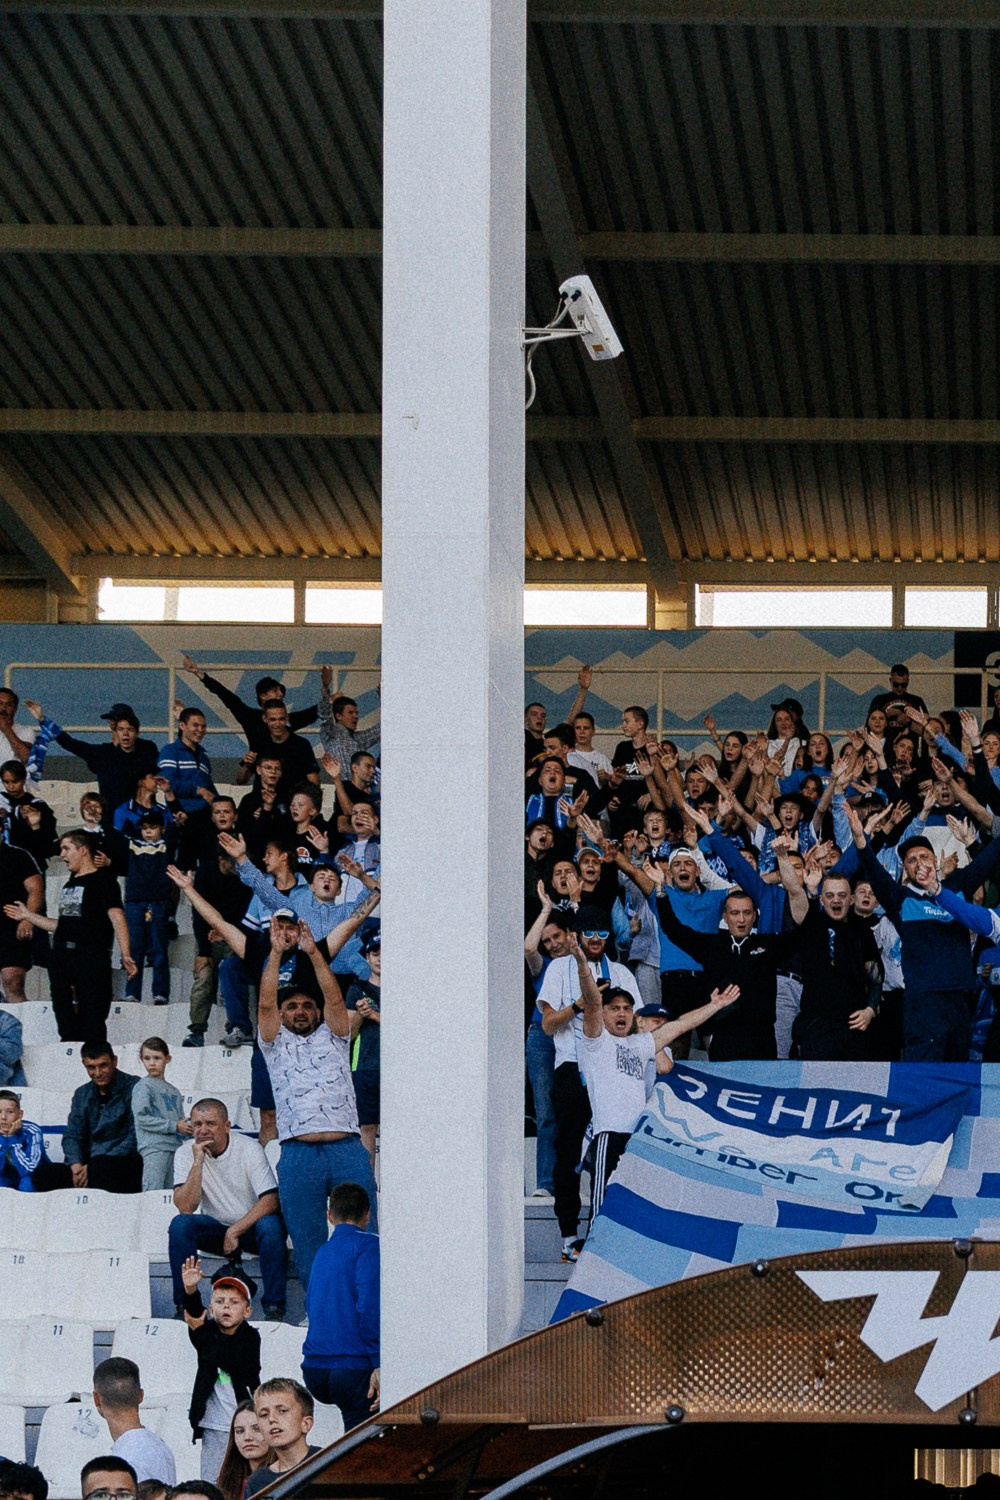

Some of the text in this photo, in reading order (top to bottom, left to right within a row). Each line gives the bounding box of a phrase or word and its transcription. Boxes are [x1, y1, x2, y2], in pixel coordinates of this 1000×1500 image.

[677, 1073, 901, 1136] ЗЕНИТ
[809, 1147, 917, 1182] Are
[845, 1180, 904, 1204] On
[145, 1324, 158, 1336] 12
